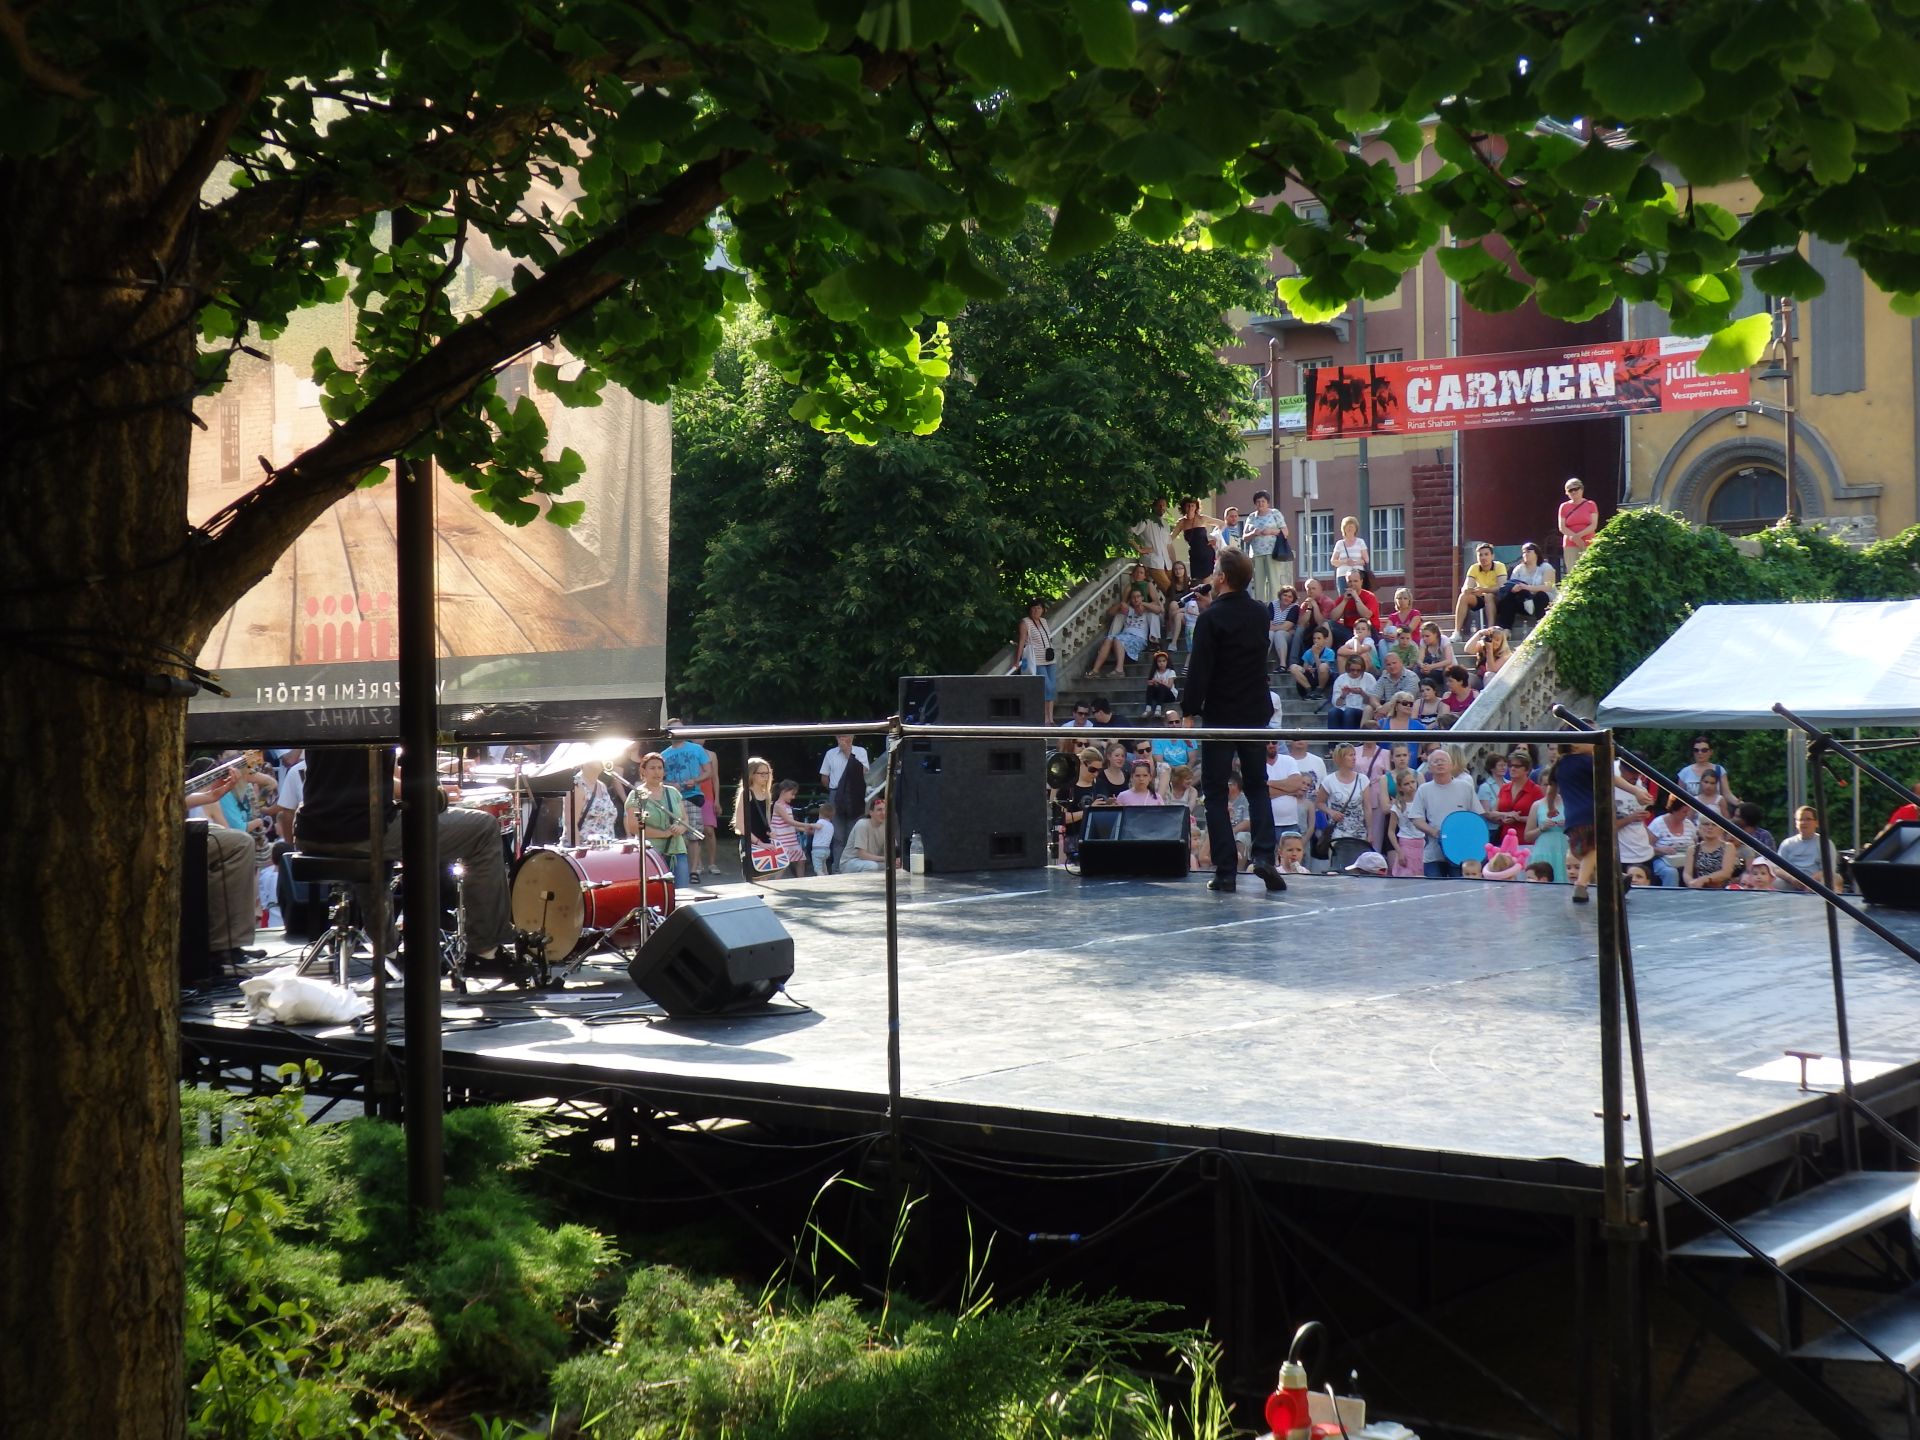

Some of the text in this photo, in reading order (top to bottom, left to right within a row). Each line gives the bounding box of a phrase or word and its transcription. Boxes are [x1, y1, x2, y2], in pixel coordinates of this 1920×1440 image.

[1591, 348, 1614, 356] részben
[1406, 365, 1429, 373] Georges
[1407, 360, 1617, 413] CARMEN
[1672, 387, 1738, 400] Veszprém Aréna
[1407, 419, 1457, 429] Rinat Shaham
